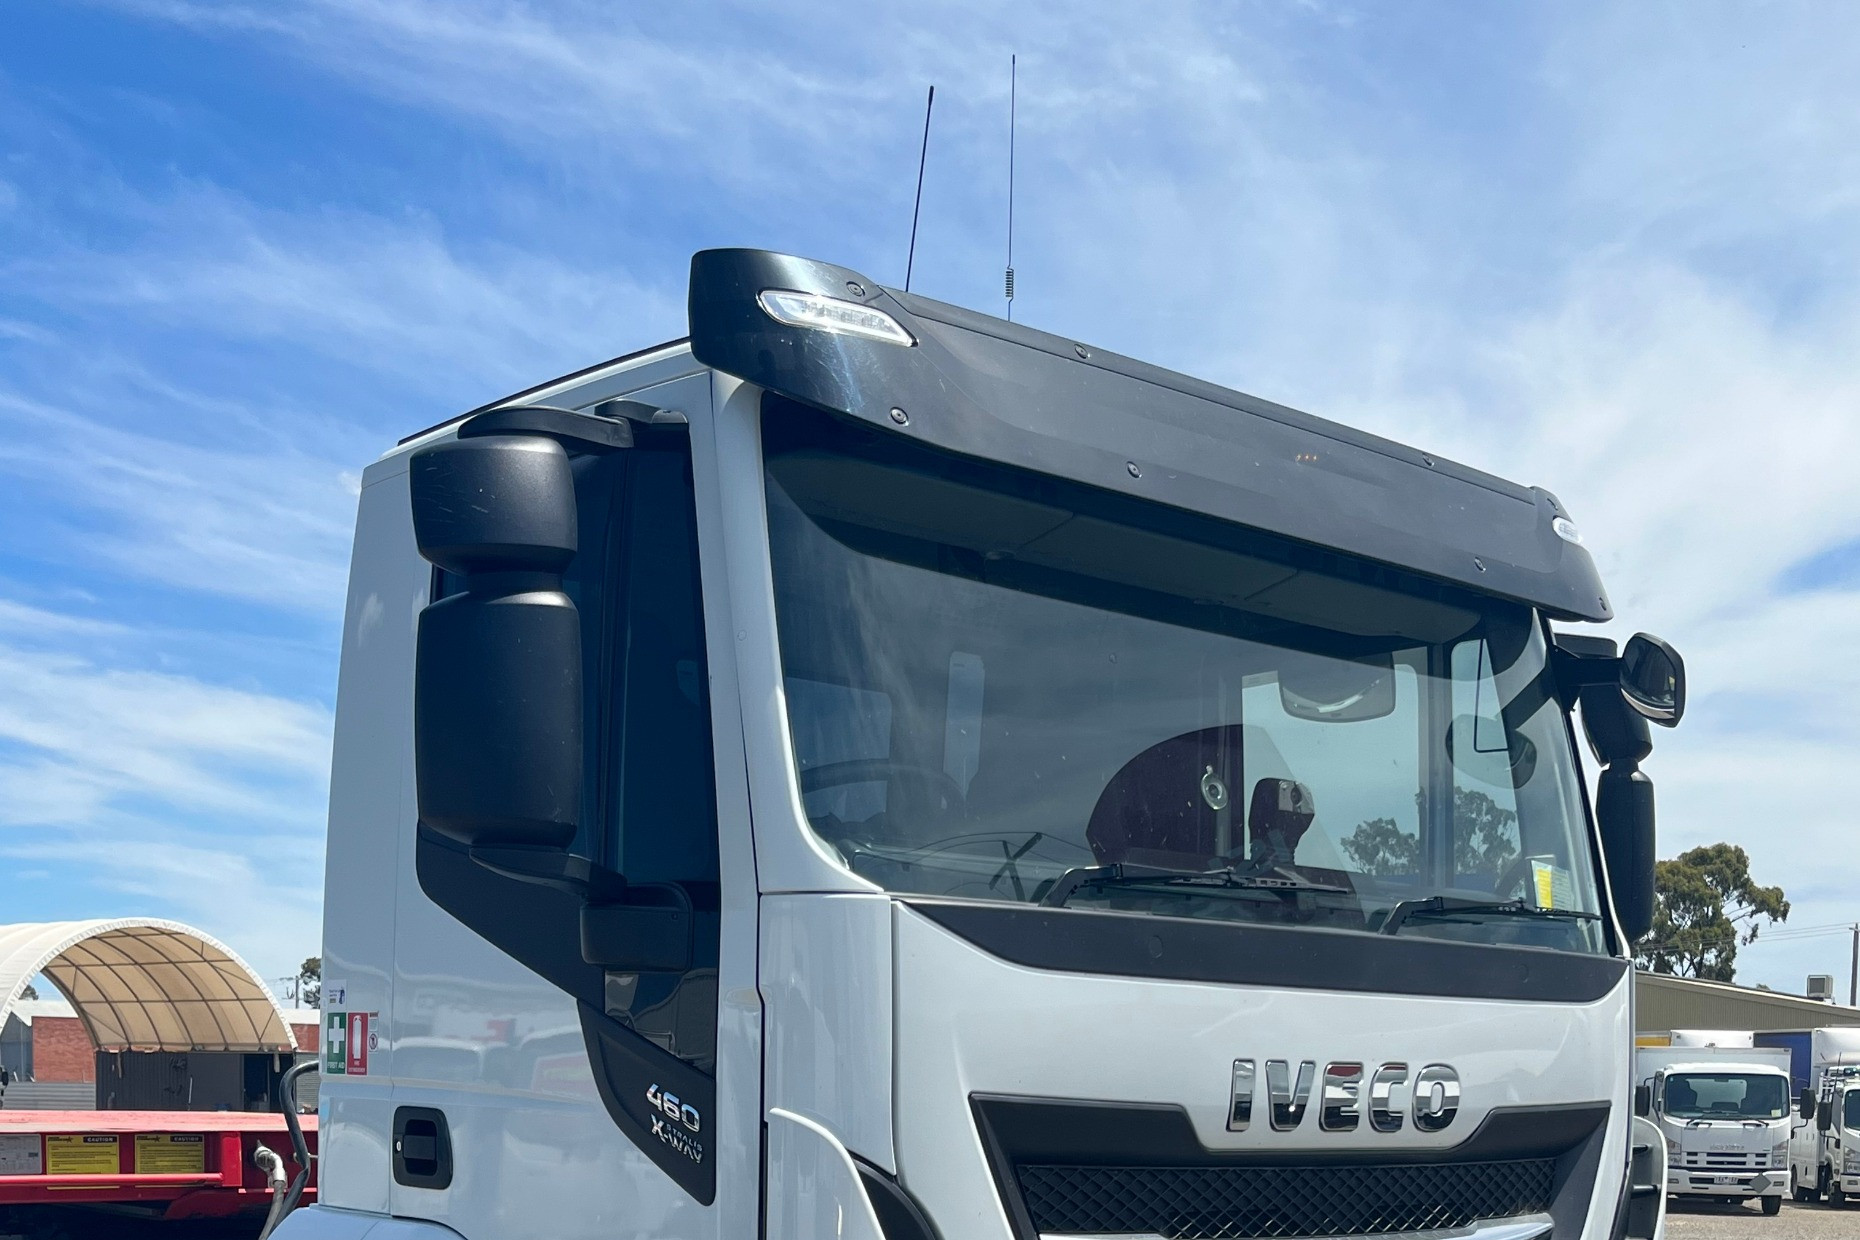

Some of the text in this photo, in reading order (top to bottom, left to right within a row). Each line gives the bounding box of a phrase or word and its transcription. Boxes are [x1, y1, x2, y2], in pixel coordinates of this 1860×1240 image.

[646, 1083, 700, 1133] 460
[1226, 1058, 1461, 1132] IVECO
[666, 1123, 703, 1152] STRALIS
